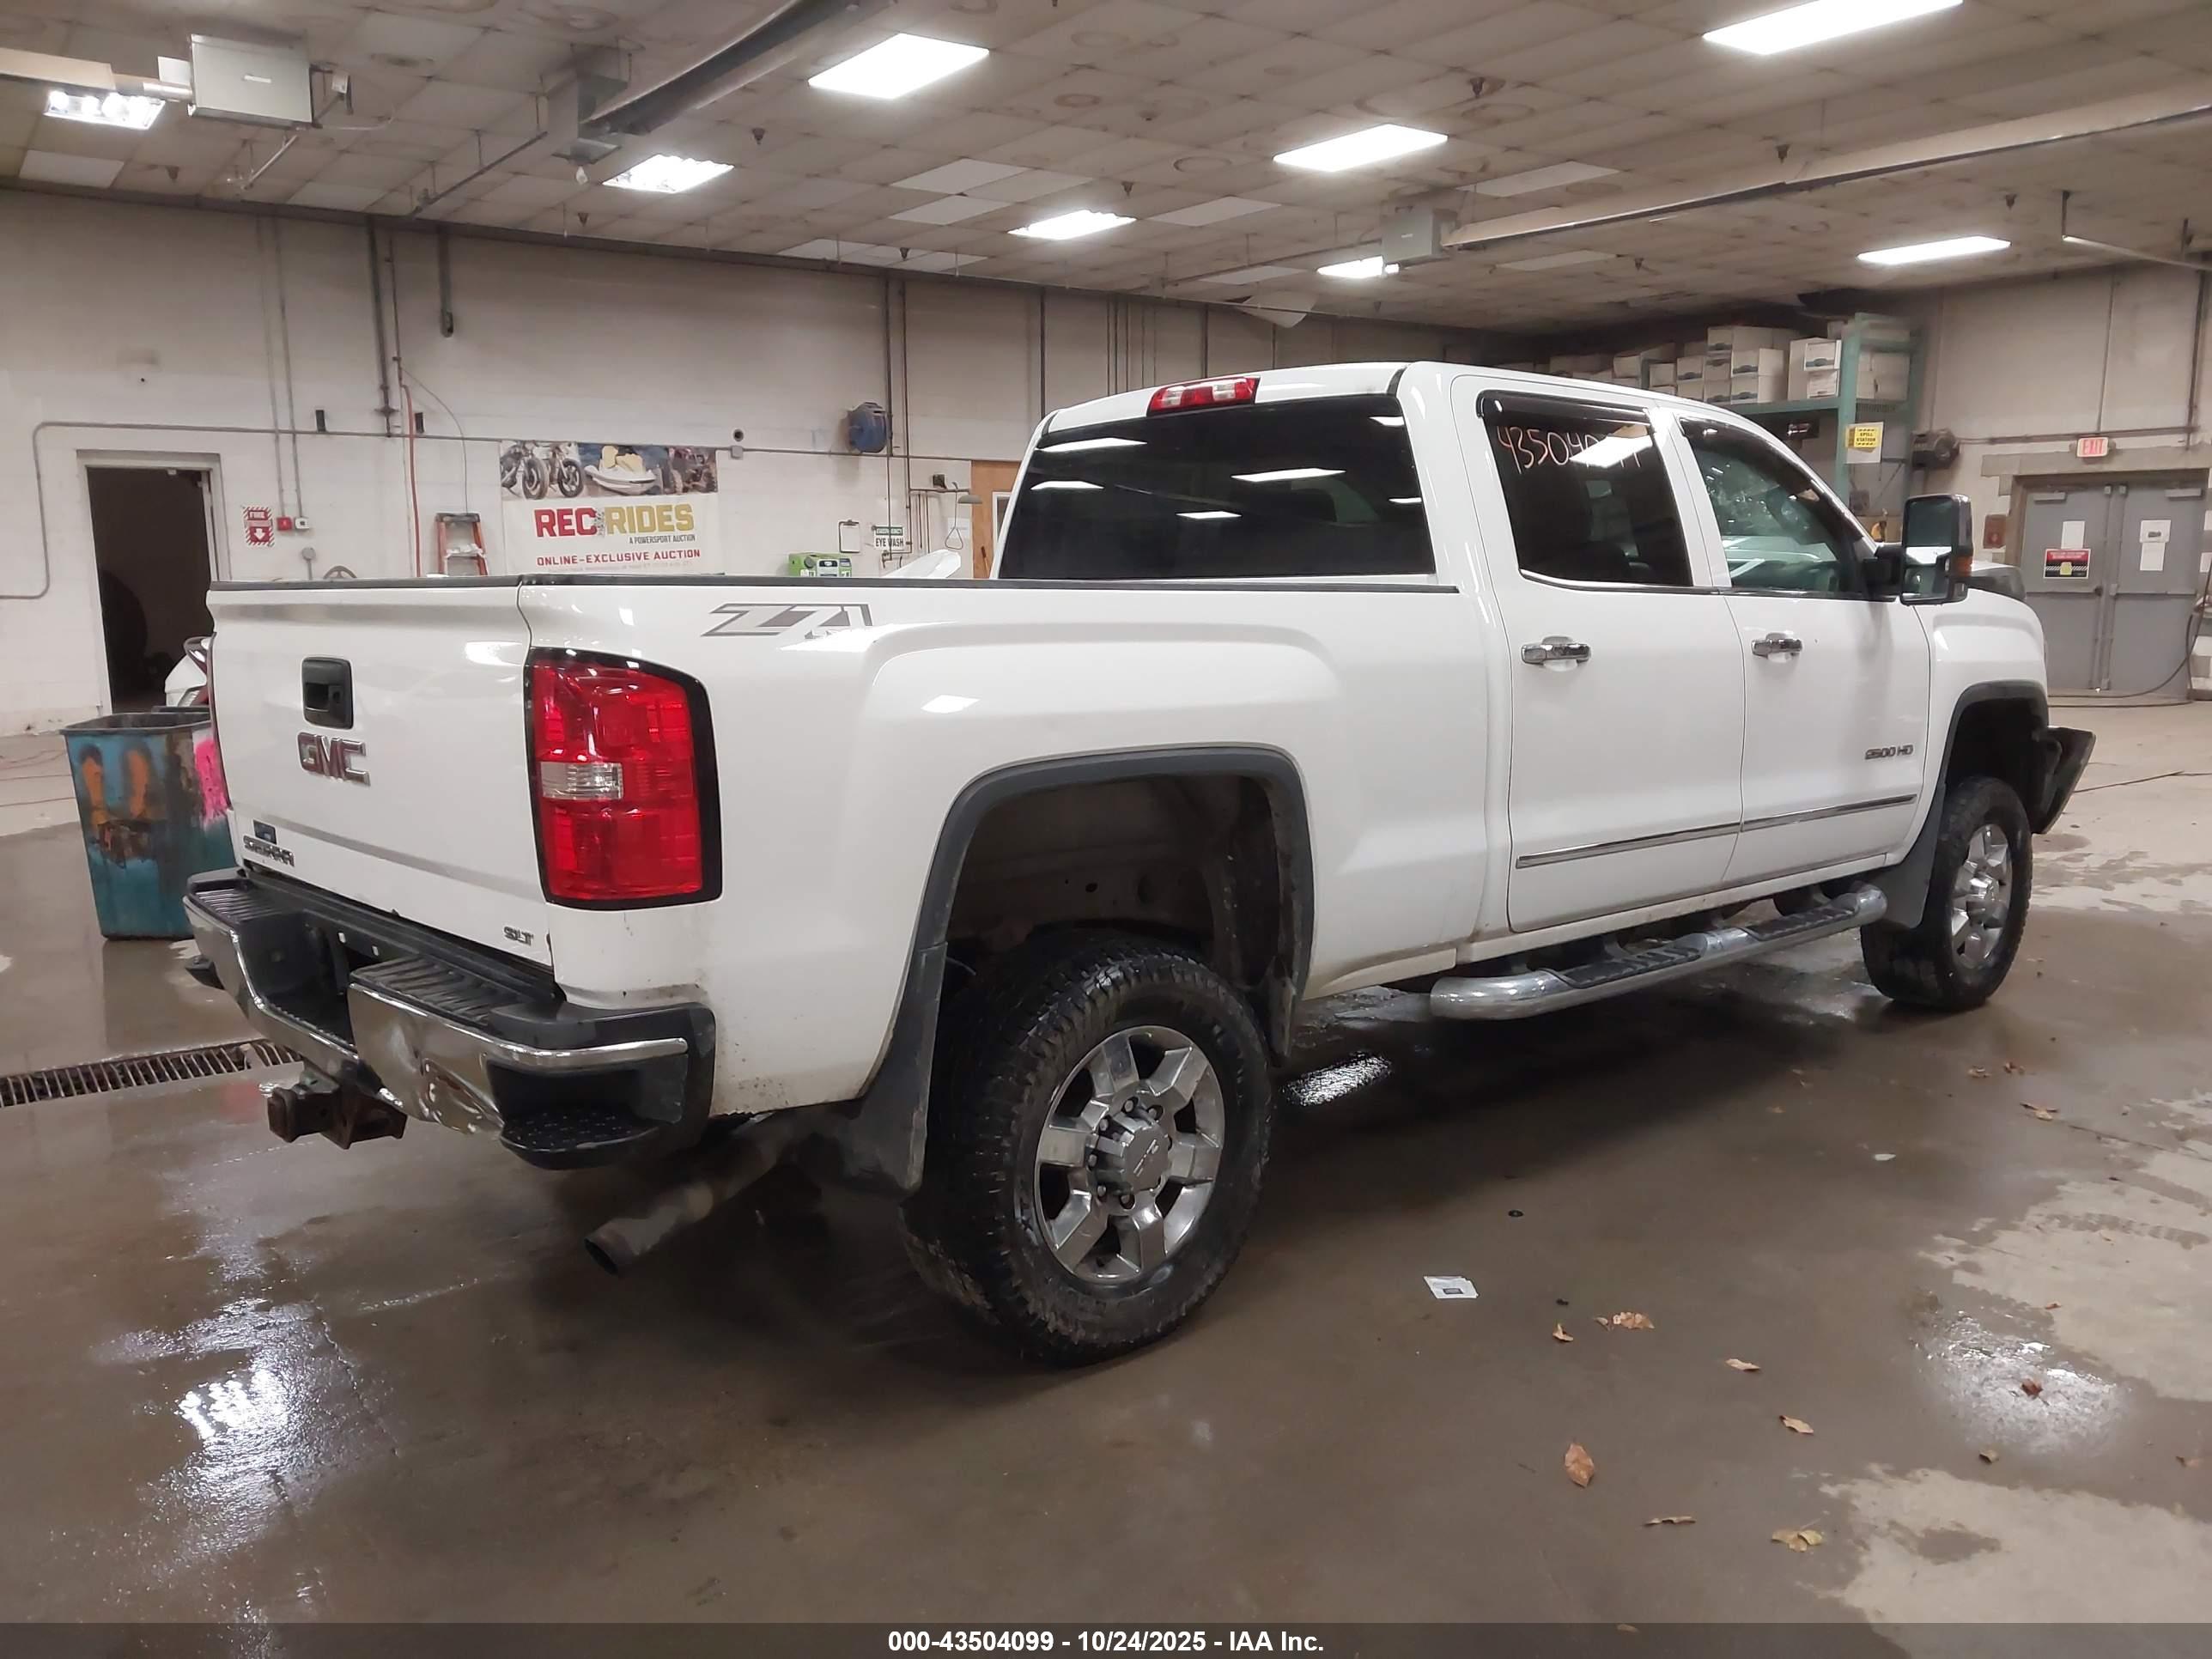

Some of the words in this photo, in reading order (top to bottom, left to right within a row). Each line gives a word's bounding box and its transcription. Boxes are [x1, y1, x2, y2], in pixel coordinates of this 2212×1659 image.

[2082, 439, 2103, 454] EXIT
[534, 507, 598, 538] REC
[605, 504, 695, 535] RIDES
[672, 534, 696, 543] AUCTION
[876, 538, 886, 547] EYE
[888, 538, 903, 547] WASH
[537, 551, 650, 567] ONLINE-EXCLUSIVE
[653, 549, 701, 560] AUCTION
[1897, 744, 1913, 756] HD
[297, 732, 371, 787] GMC
[504, 926, 533, 946] SLT
